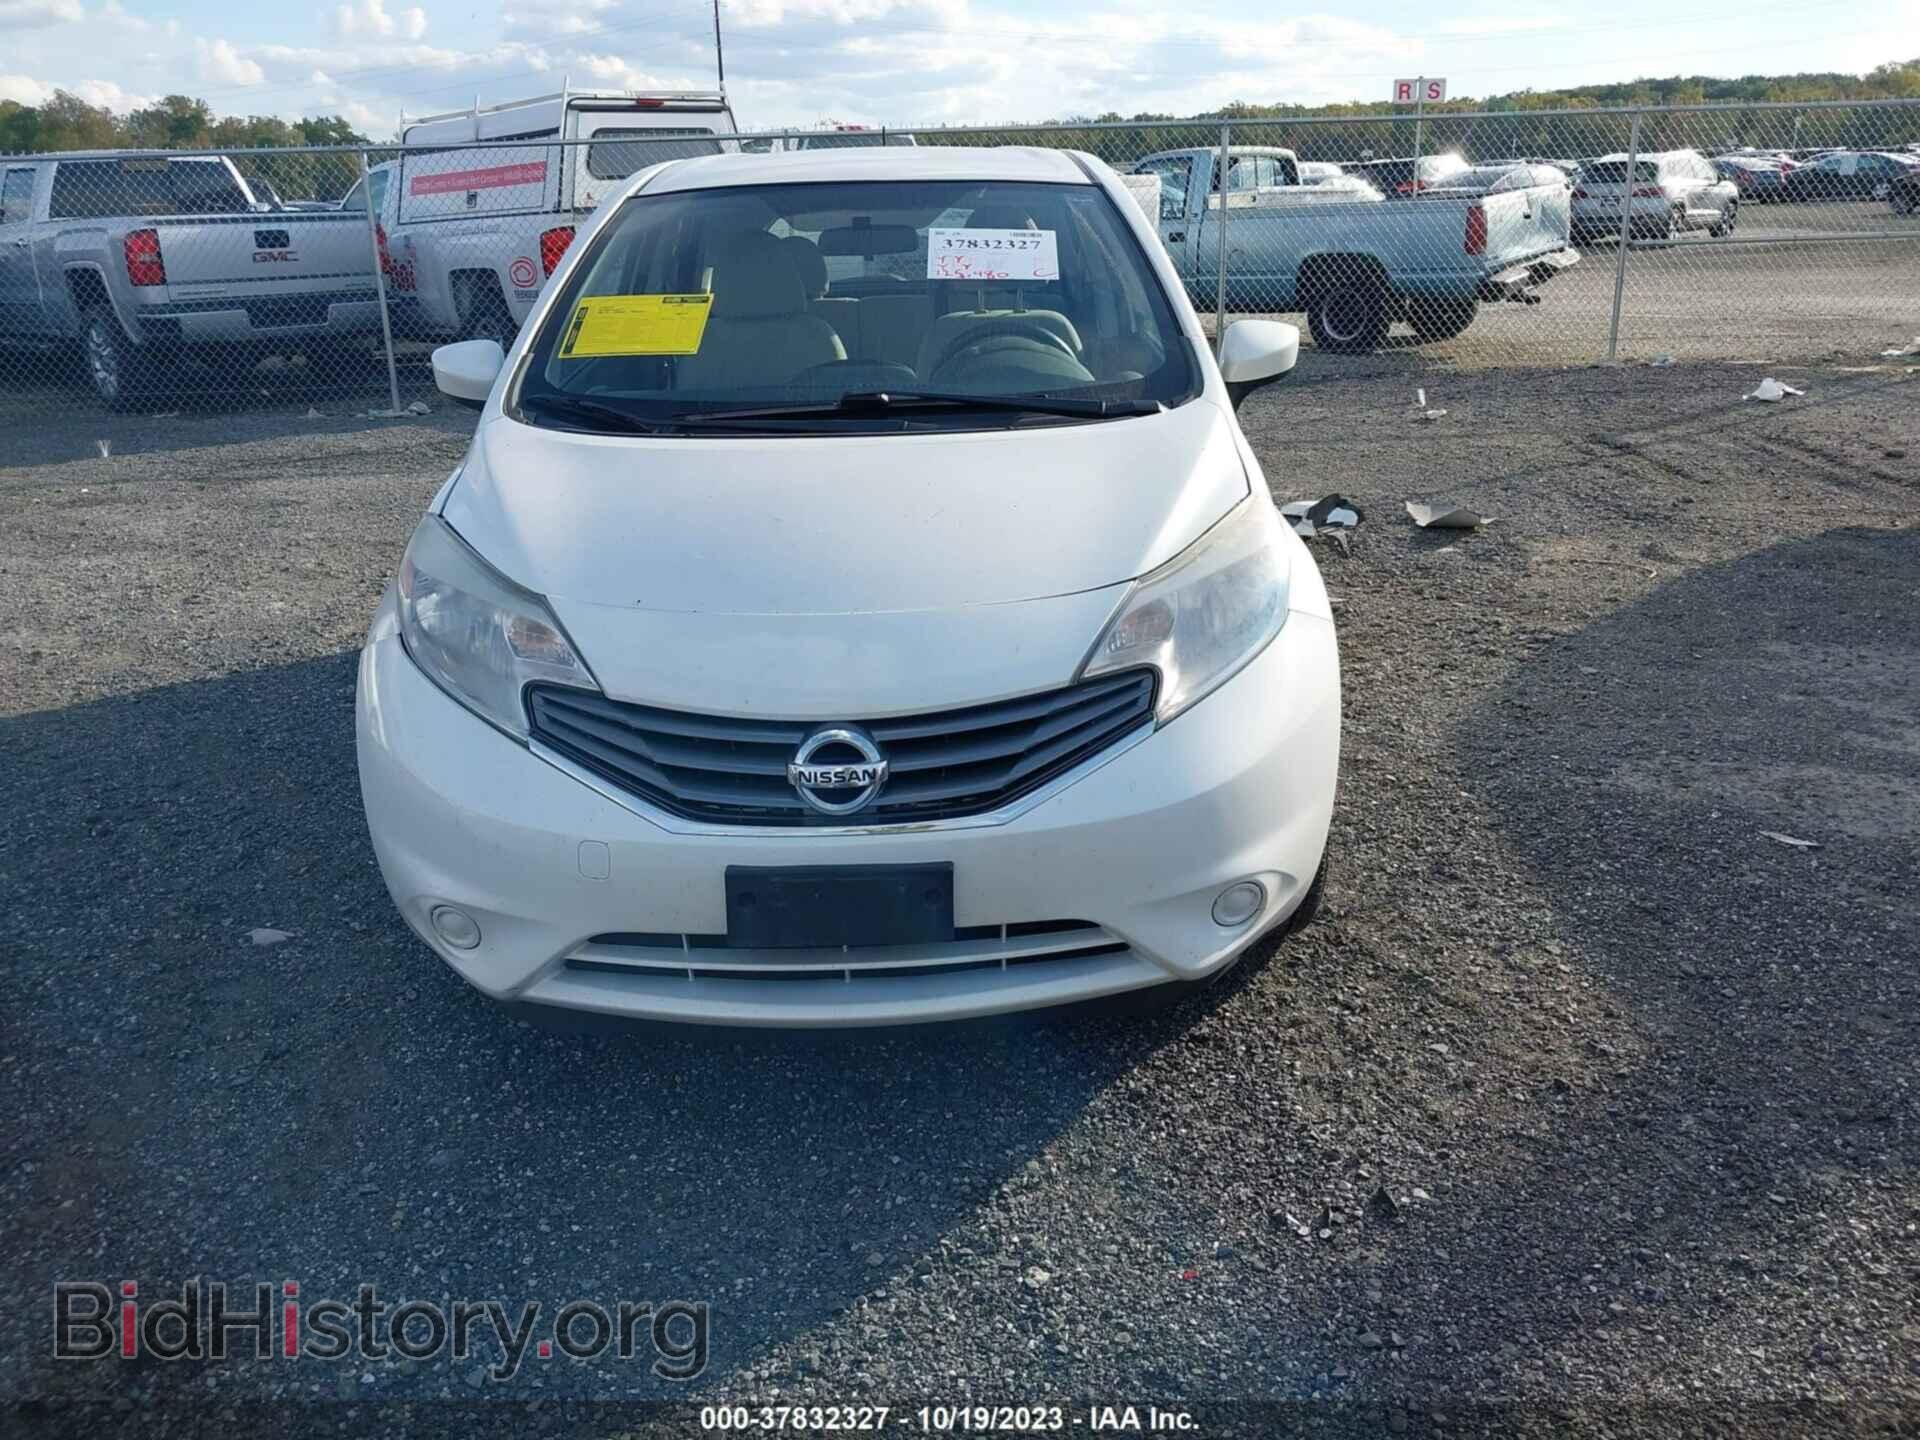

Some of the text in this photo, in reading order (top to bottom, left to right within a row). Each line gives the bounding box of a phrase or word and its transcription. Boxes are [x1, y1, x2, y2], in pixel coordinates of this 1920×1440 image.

[1399, 83, 1411, 100] R
[1428, 82, 1441, 99] S
[942, 239, 1041, 250] 37832327
[253, 251, 299, 264] GMC
[798, 767, 877, 784] NISSAN
